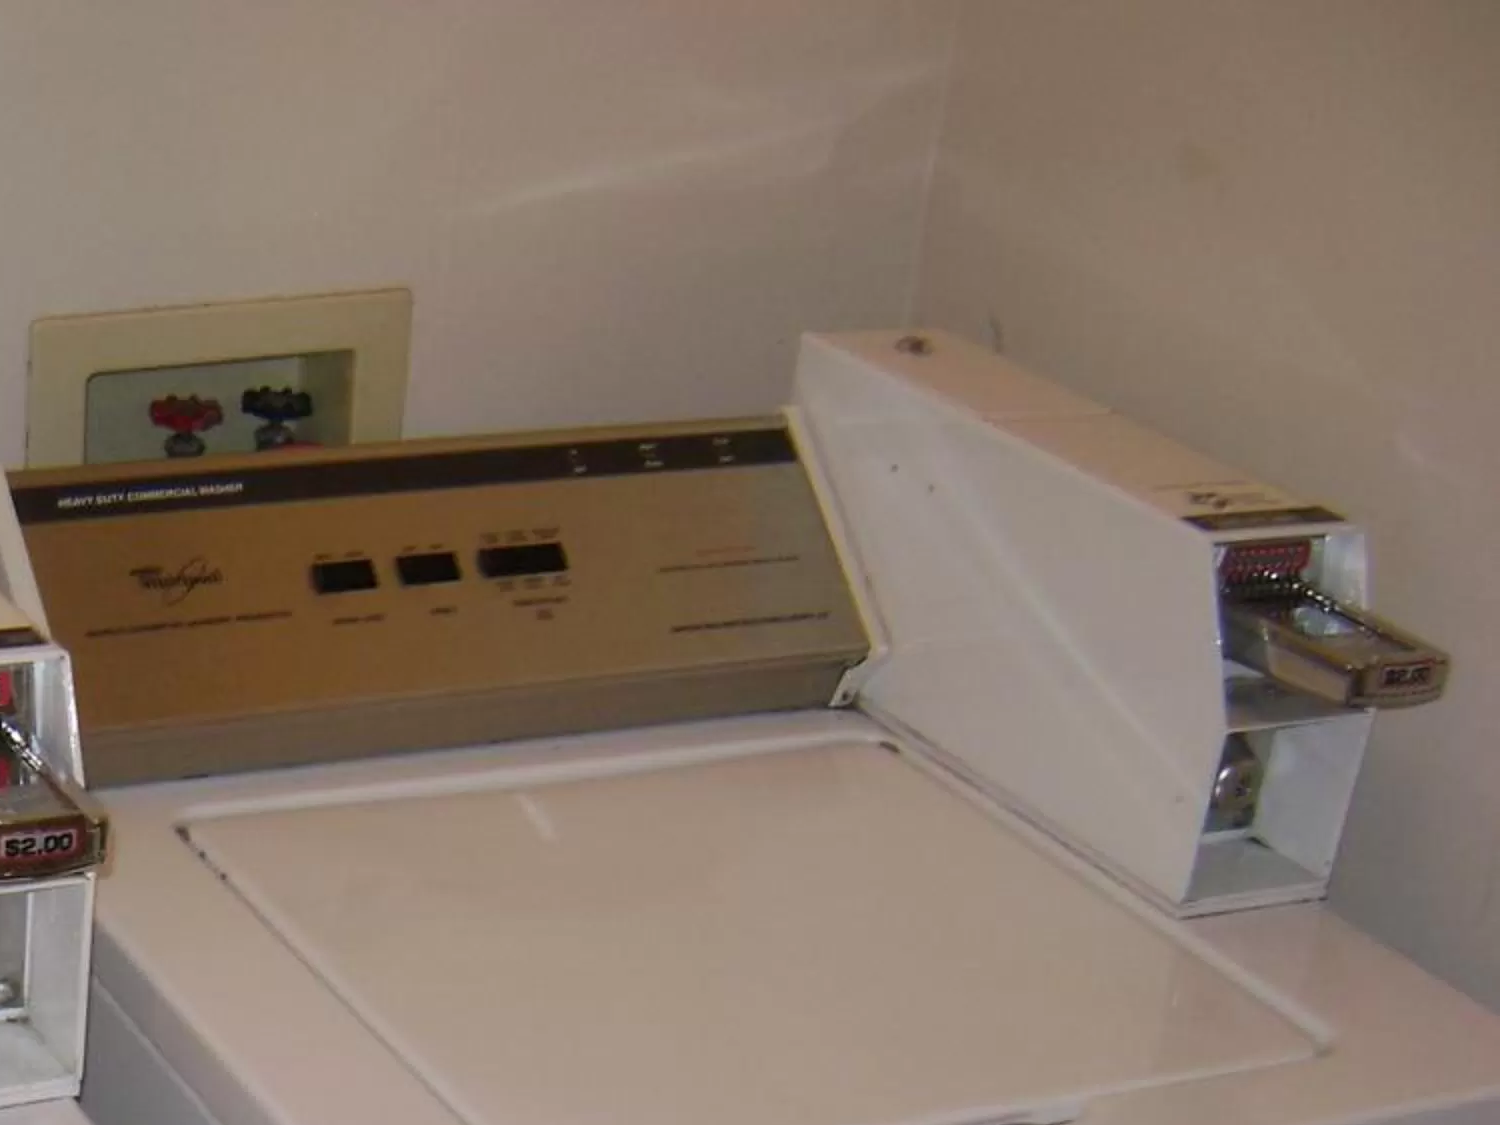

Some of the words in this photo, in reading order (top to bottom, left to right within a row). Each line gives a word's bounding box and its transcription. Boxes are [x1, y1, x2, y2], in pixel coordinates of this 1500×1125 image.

[57, 495, 94, 508] HEAVY
[96, 493, 124, 505] DUTY
[127, 486, 198, 502] COMMERCIAL
[200, 482, 244, 497] WASHER
[4, 832, 74, 857] $2.00
